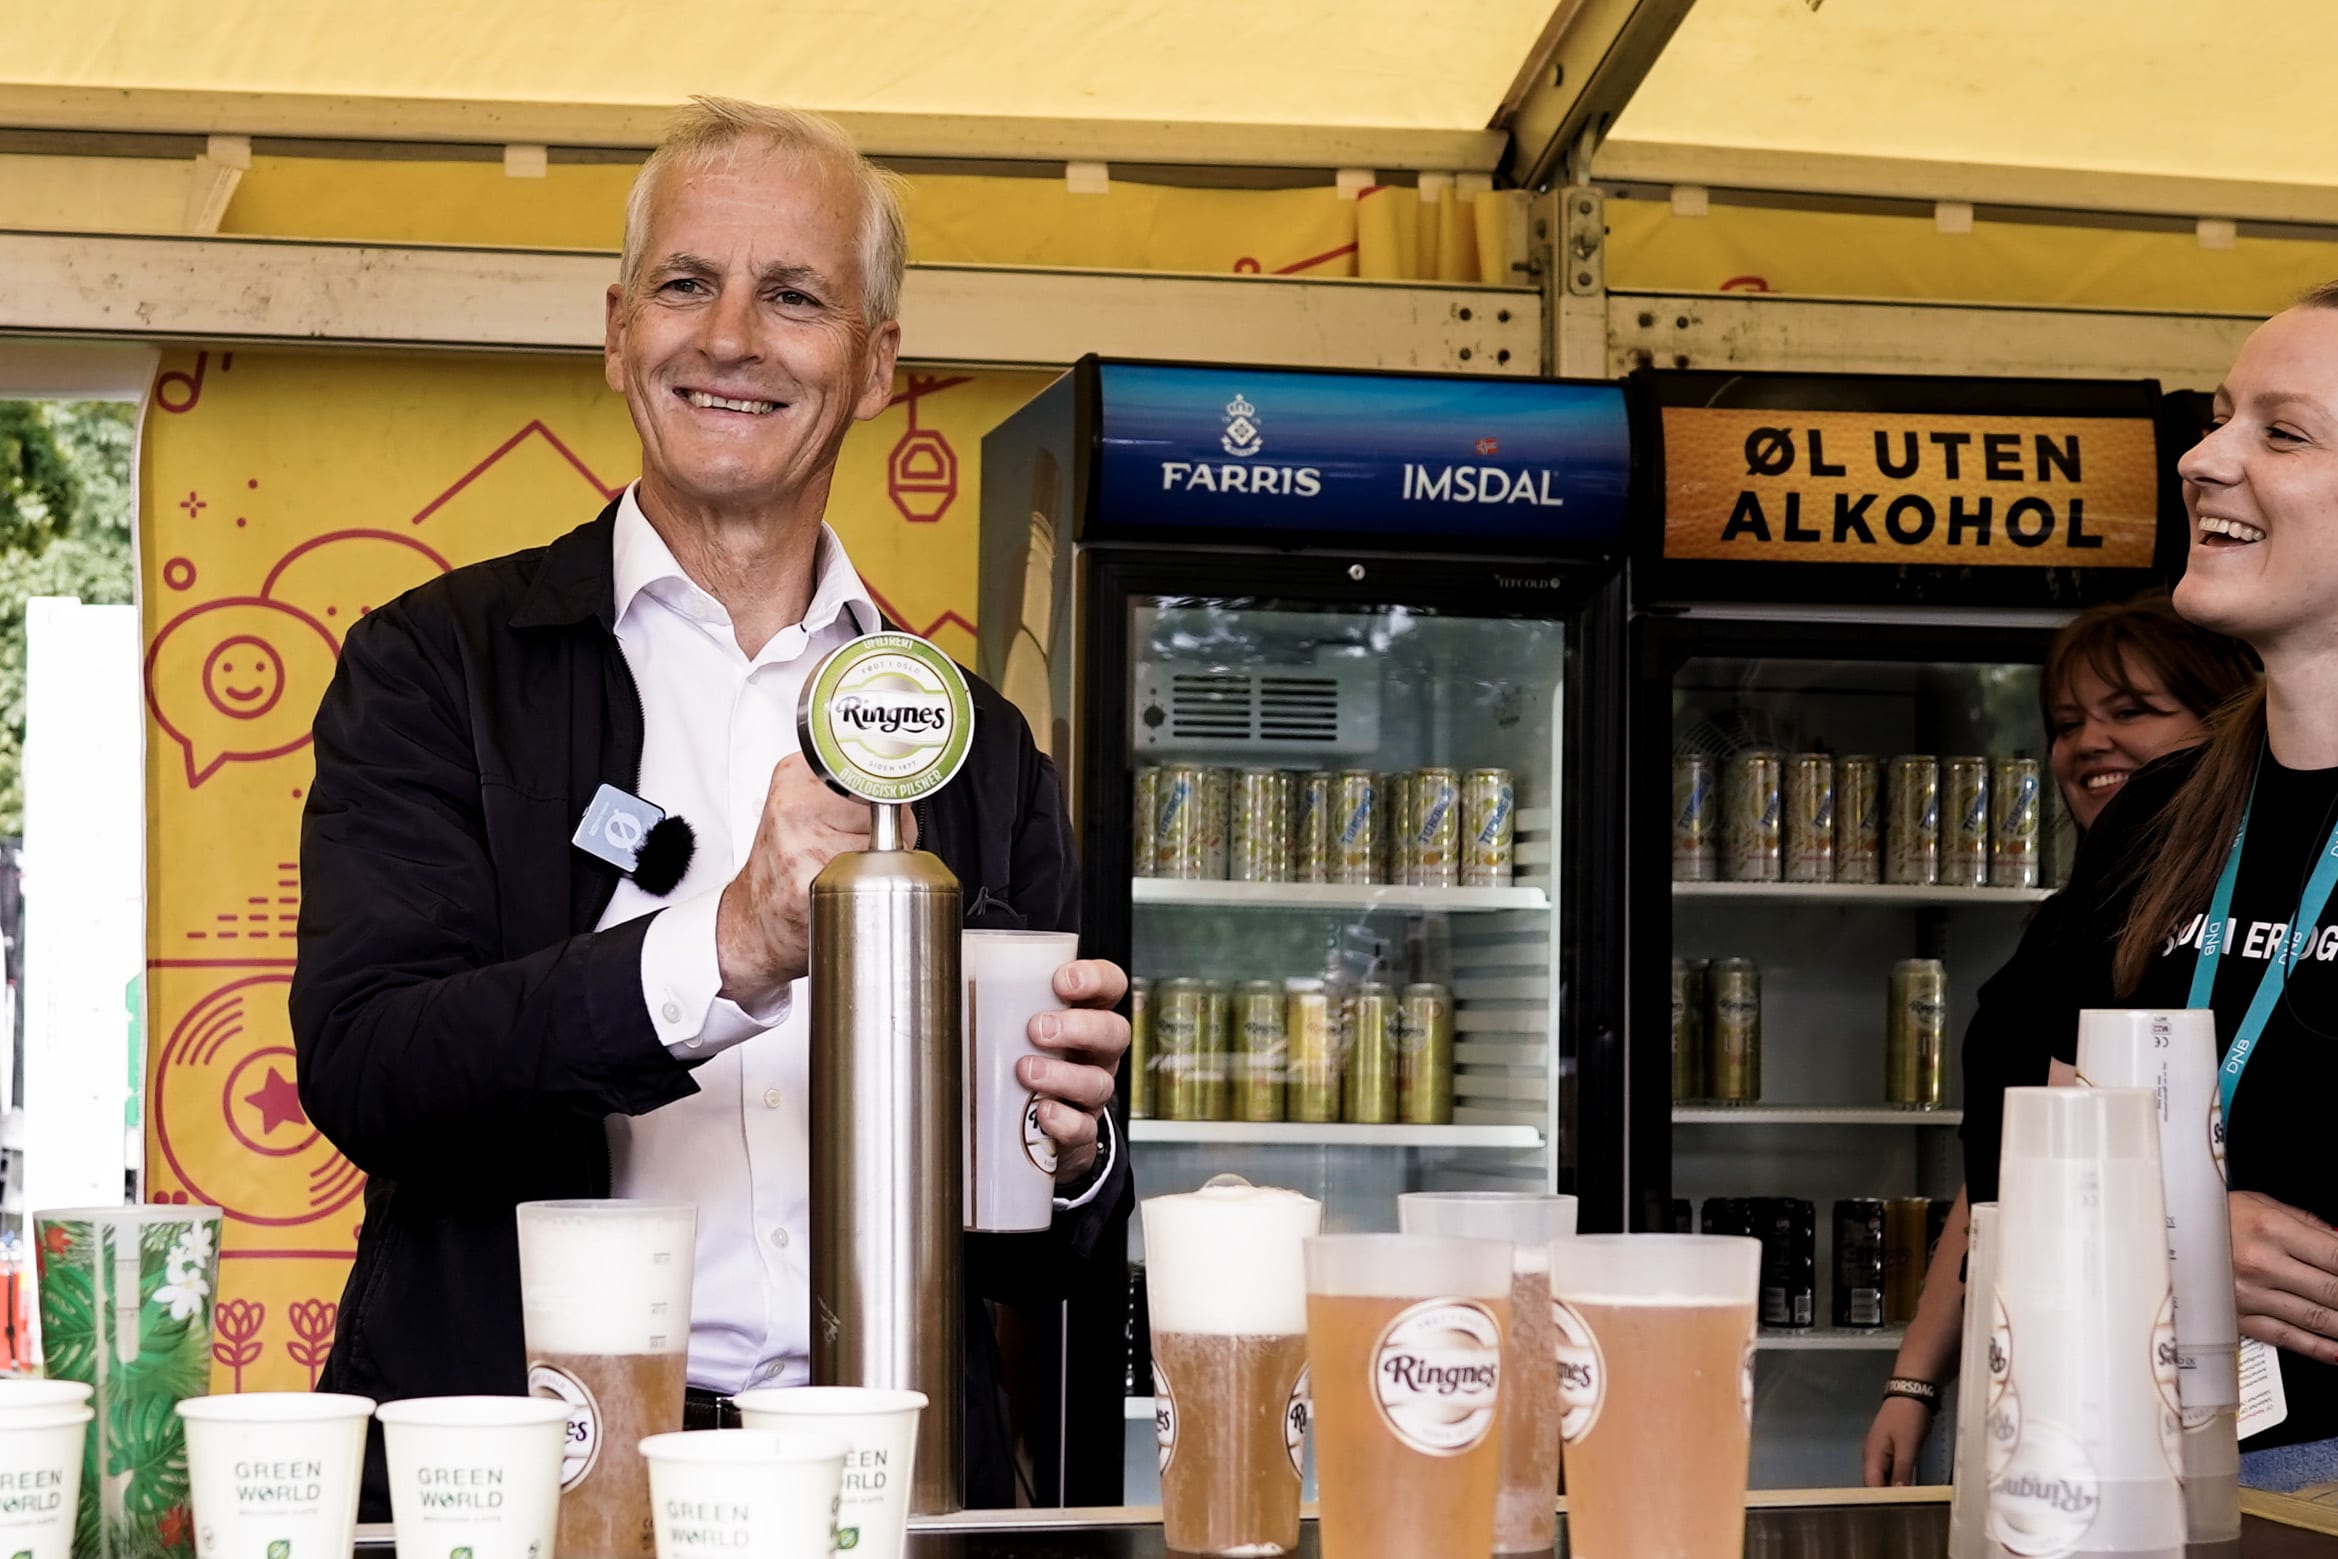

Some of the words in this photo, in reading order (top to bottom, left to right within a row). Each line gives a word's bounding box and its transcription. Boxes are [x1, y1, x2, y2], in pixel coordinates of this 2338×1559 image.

[1743, 426, 1846, 478] ØL
[1873, 430, 2082, 483] UTEN
[1161, 461, 1322, 497] FARRIS
[1402, 463, 1564, 507] IMSDAL
[1720, 490, 2104, 548] ALKOHOL
[836, 695, 946, 733] Ringnes
[838, 767, 898, 798] ØKOLOGISK
[900, 768, 943, 797] PILSNER
[2203, 921, 2222, 957] DNB
[2226, 1039, 2251, 1074] DNB
[1383, 1354, 1497, 1395] Ringnes
[234, 1460, 323, 1480] GREEN
[417, 1467, 504, 1486] GREEN
[666, 1499, 749, 1523] GREEN
